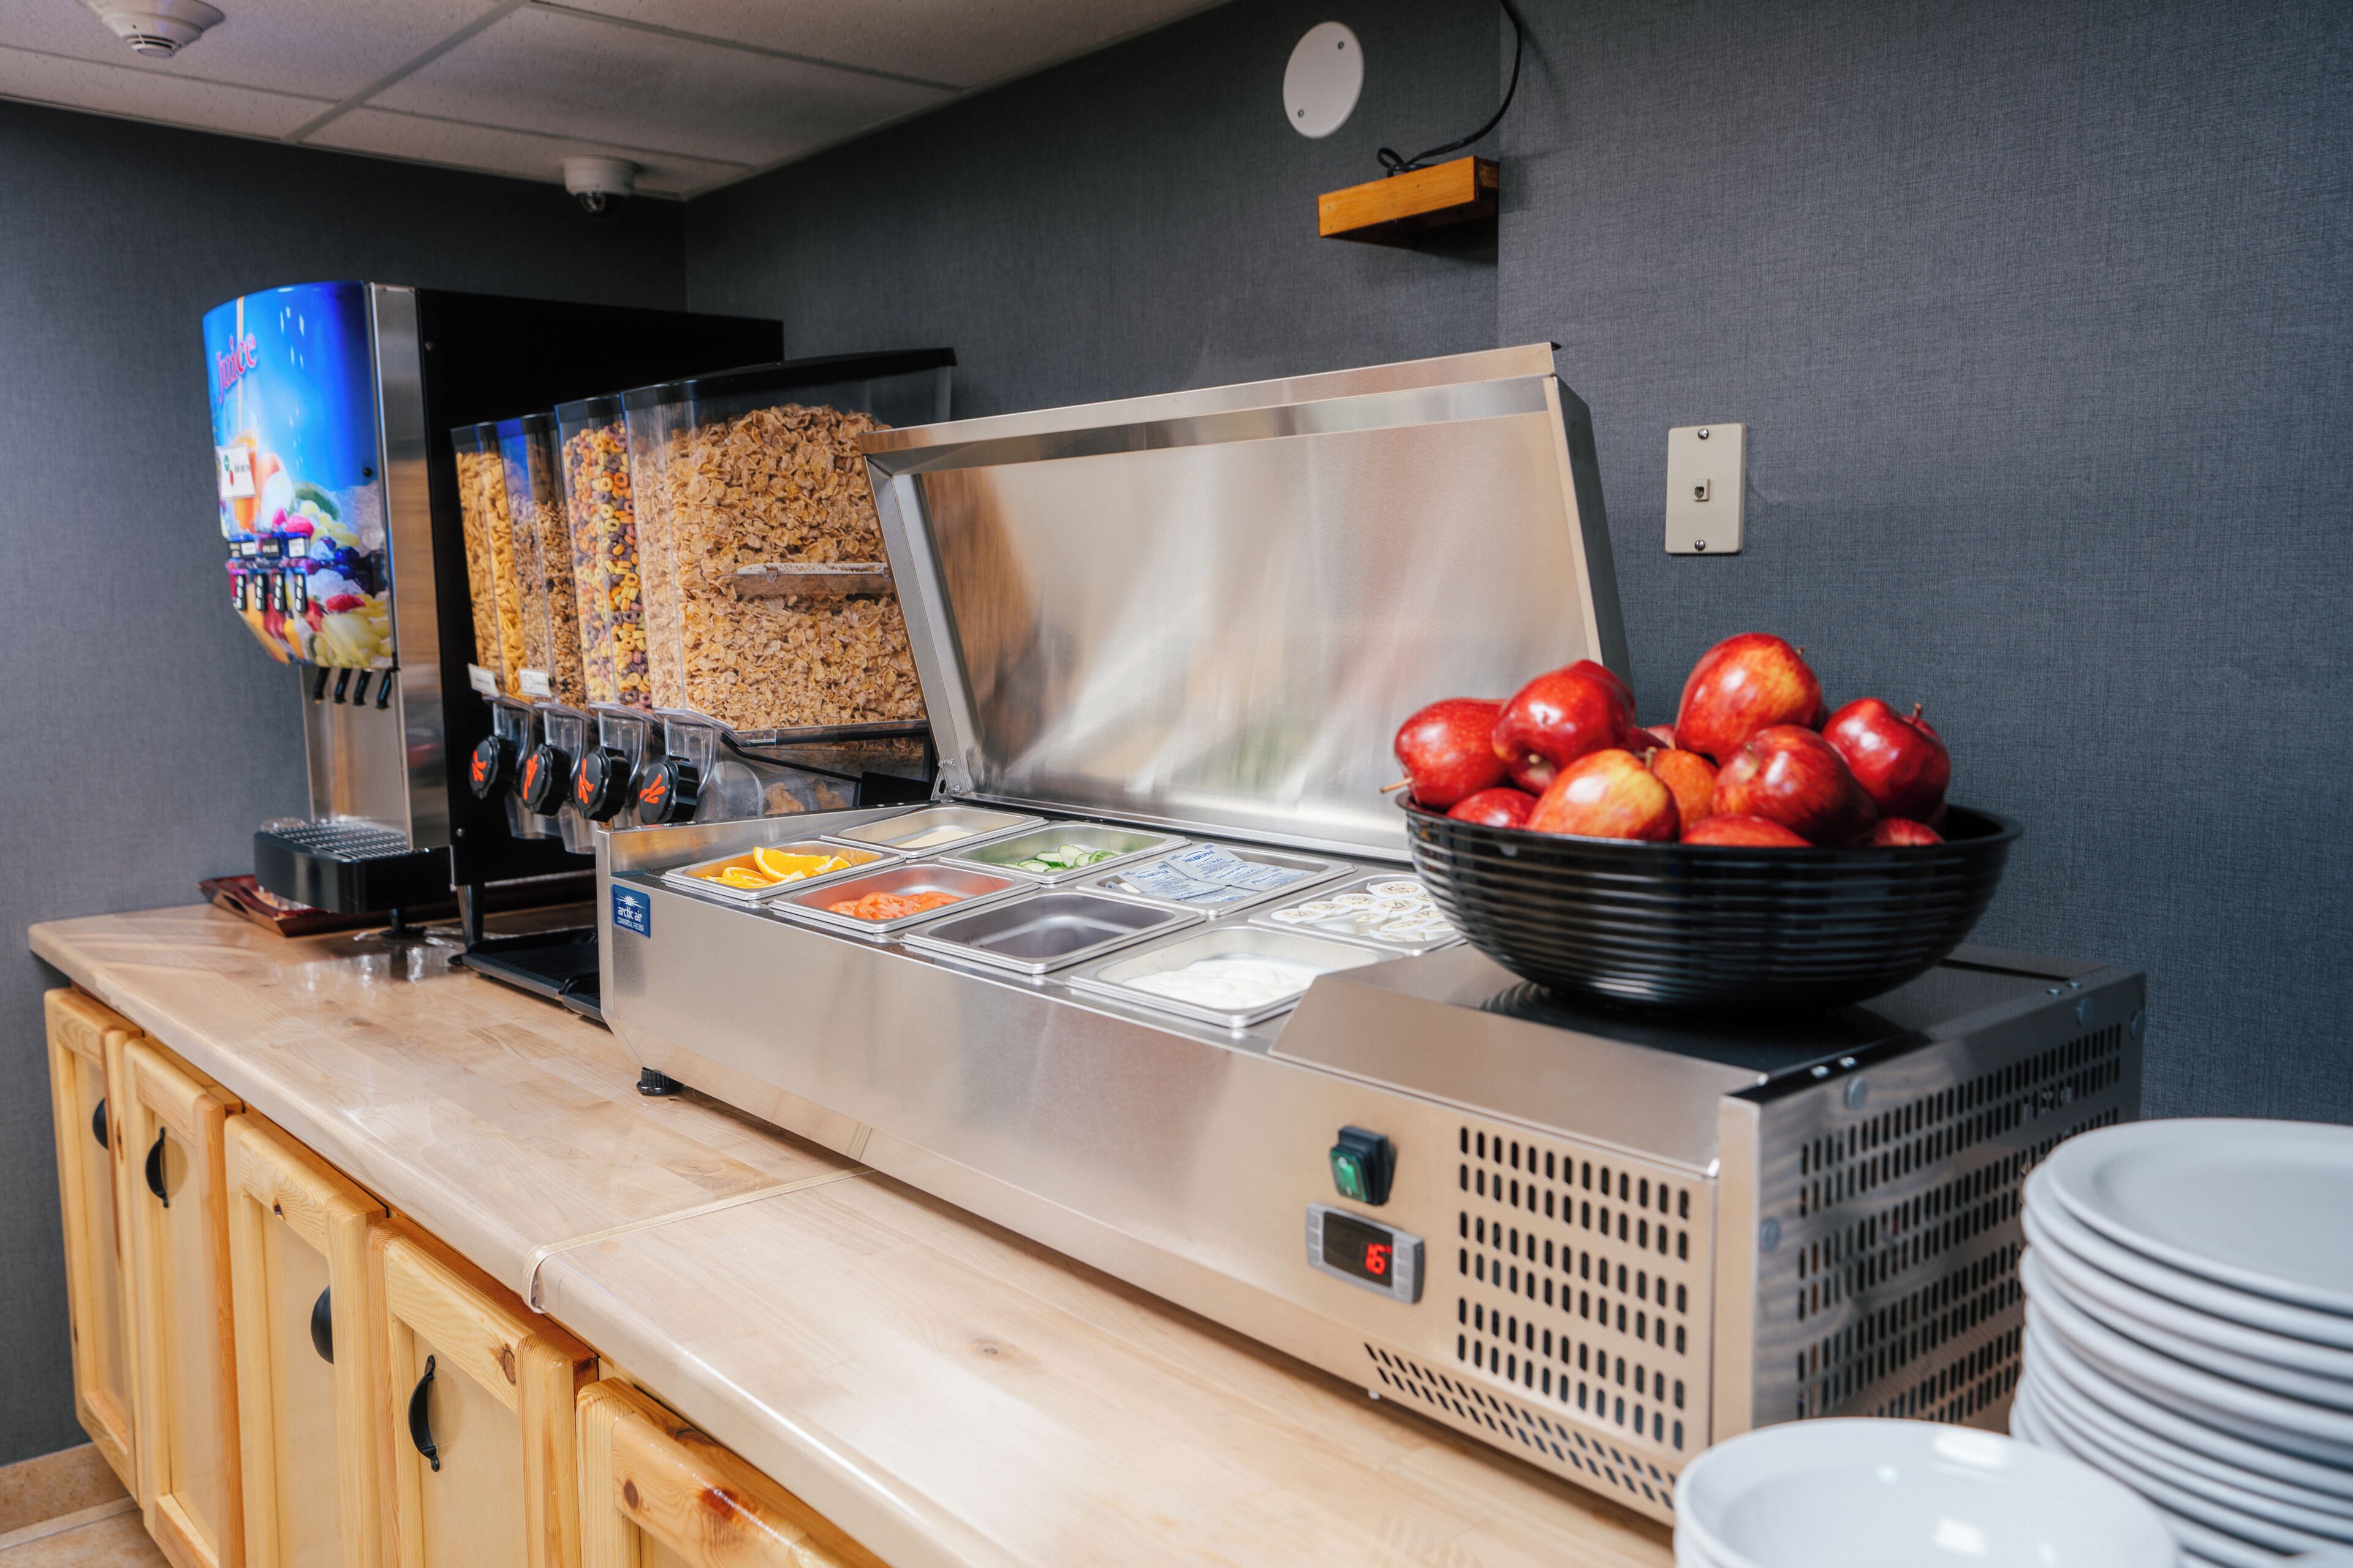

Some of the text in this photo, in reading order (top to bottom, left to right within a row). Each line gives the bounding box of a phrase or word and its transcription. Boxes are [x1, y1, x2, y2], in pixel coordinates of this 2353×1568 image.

[216, 334, 257, 405] Juice
[1181, 850, 1216, 863] PHILADELPHIA
[1195, 857, 1224, 868] ORIGINAL
[618, 906, 634, 919] arctic
